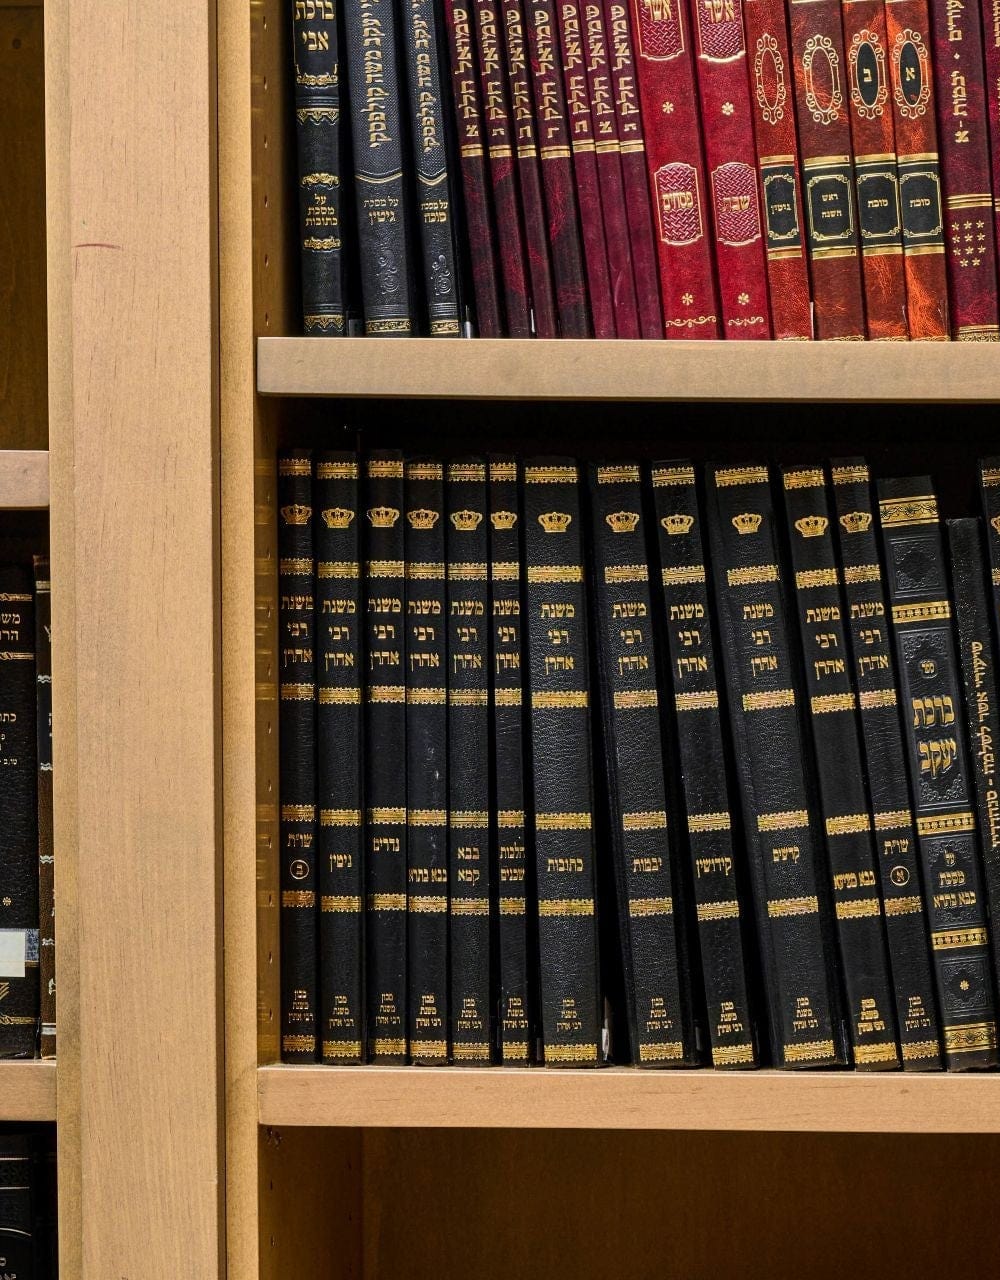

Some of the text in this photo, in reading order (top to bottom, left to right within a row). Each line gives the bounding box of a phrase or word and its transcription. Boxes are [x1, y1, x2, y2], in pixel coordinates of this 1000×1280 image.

[303, 31, 328, 50] אבי
[453, 9, 479, 136] שמואל חלק א
[864, 69, 872, 82] ב
[906, 68, 915, 81] א
[662, 190, 693, 211] פסחים
[323, 600, 355, 613] משנת
[408, 600, 441, 614] משנת
[541, 604, 574, 619] משנת
[671, 604, 704, 620] משנת
[807, 607, 840, 623] משנת
[329, 627, 349, 640] רבי
[414, 627, 434, 640] רבי
[548, 629, 568, 644] רבי
[679, 631, 701, 645] רבי
[816, 634, 837, 648] רבי
[325, 653, 353, 671] אהרן
[410, 653, 439, 671] אהרן
[545, 654, 573, 675] אהרן
[678, 656, 707, 678] אהרן
[815, 659, 844, 680] אהרן
[912, 695, 954, 729] ברכת
[919, 738, 957, 776] יעקב
[374, 838, 399, 851] נדרים
[500, 842, 524, 859] הלכות
[458, 847, 479, 859] בבא
[773, 845, 799, 863] קדשים
[330, 854, 351, 872] גיטין
[548, 859, 583, 871] כתובות
[633, 858, 662, 872] יבמות
[696, 857, 731, 878] קידושין
[458, 869, 480, 886] קמא
[501, 869, 524, 880] שכנים
